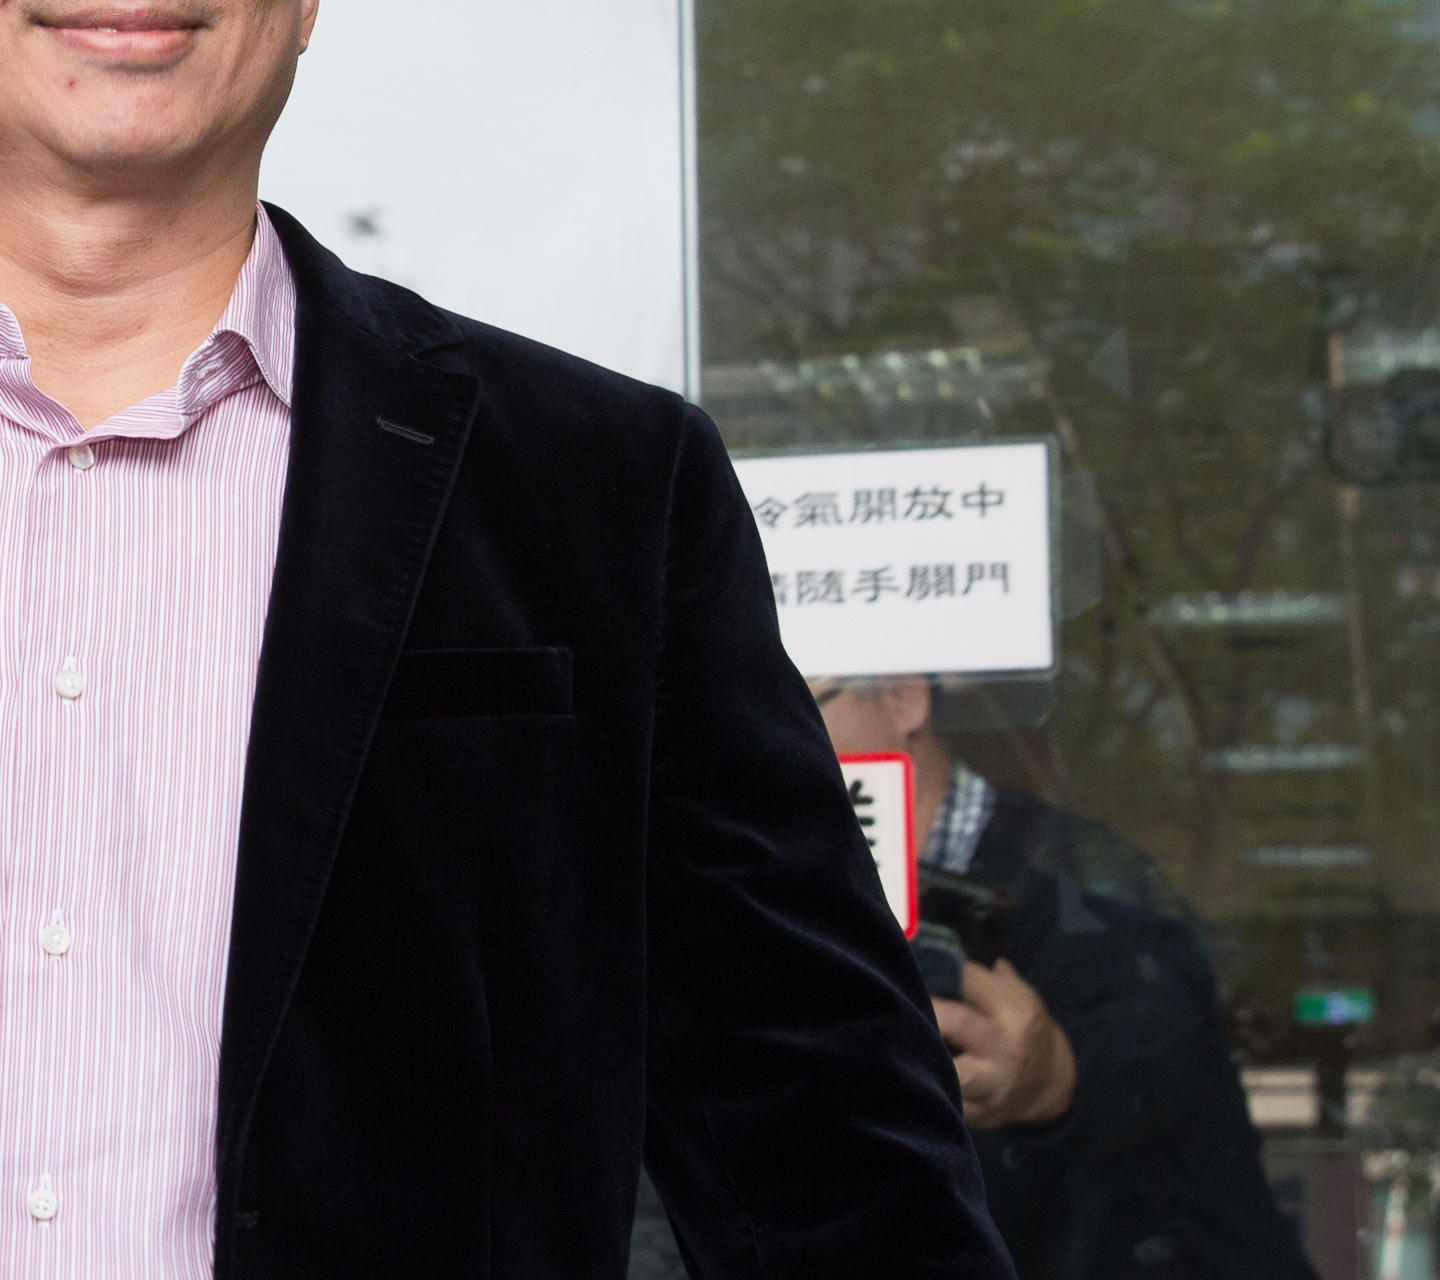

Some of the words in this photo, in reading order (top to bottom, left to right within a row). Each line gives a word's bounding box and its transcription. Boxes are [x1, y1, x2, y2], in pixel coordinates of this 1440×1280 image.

[752, 482, 1005, 529] 冷氣開放中
